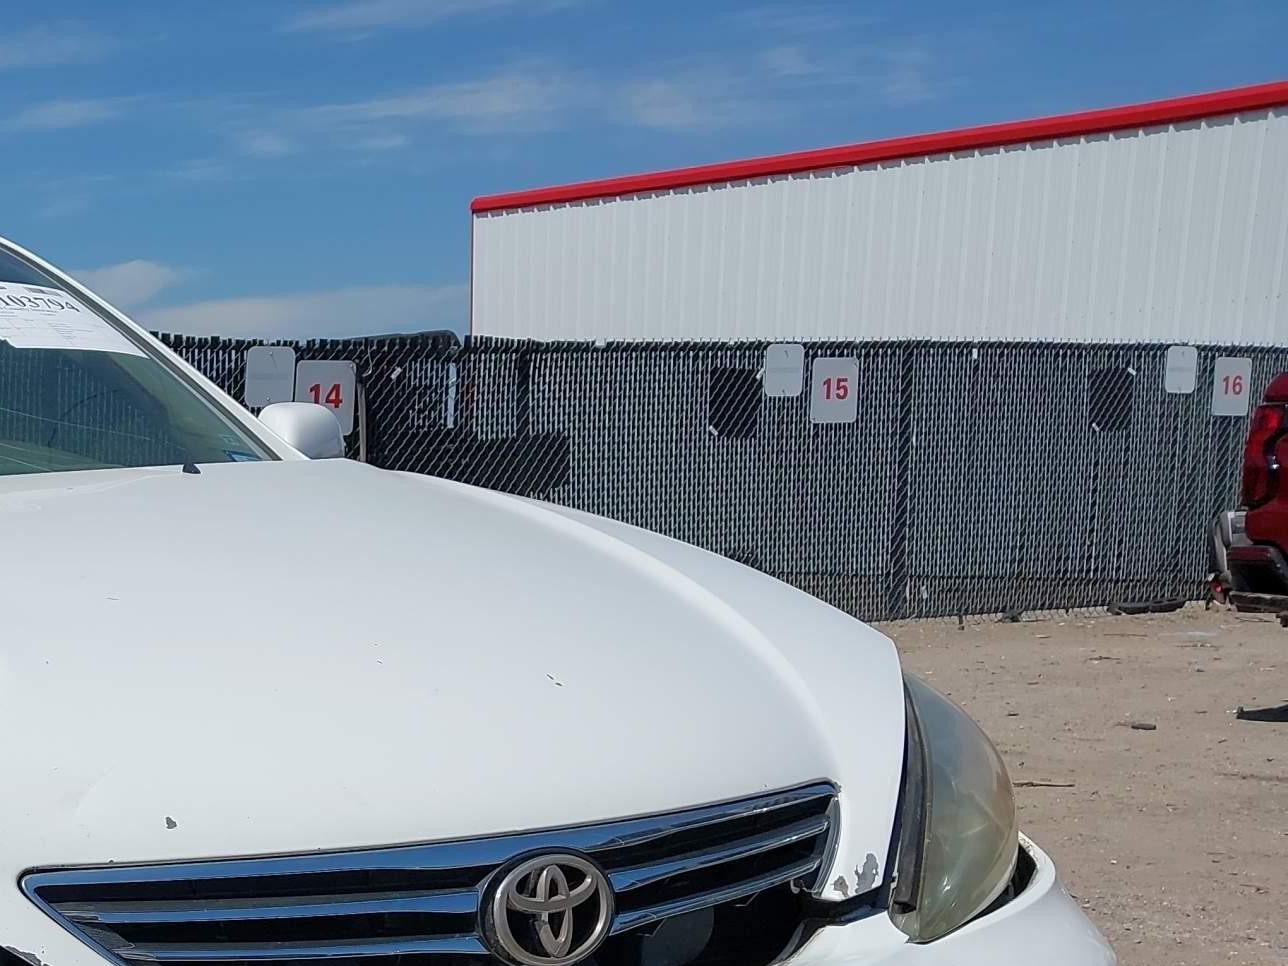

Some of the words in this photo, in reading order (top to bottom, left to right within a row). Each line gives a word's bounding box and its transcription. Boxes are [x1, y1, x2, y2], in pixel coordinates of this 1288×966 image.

[309, 383, 343, 408] 14
[823, 377, 849, 400] 15
[1222, 375, 1243, 395] 16
